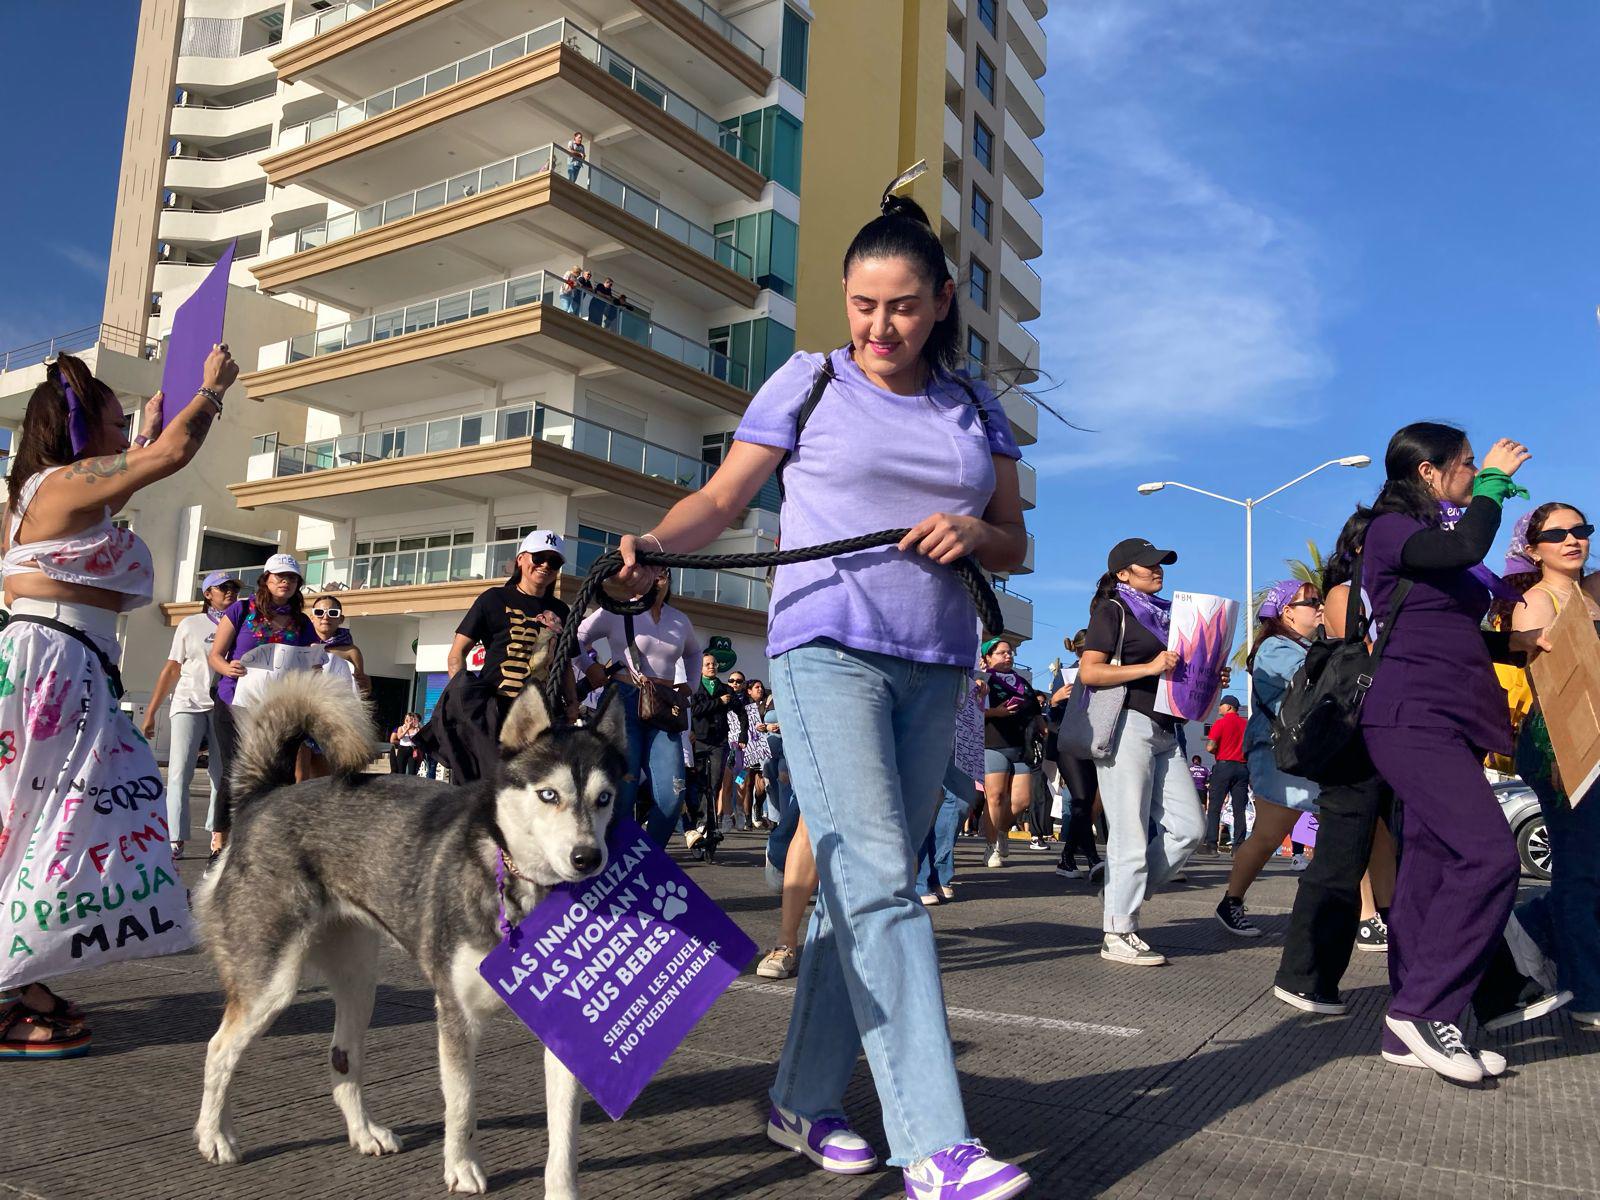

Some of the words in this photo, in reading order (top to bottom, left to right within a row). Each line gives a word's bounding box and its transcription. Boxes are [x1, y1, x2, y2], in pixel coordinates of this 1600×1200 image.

[545, 533, 557, 547] NY
[499, 952, 538, 996] LAS
[534, 838, 652, 958] INMOBILIZAN
[529, 960, 570, 1001] LAS
[564, 887, 638, 961] VIOLAN
[632, 872, 651, 892] Y
[562, 923, 638, 1000] VENDEN
[637, 910, 656, 931] A
[582, 981, 620, 1023] SUS
[615, 928, 676, 986] BEBES.
[603, 995, 649, 1047] SIENTEN
[647, 971, 669, 996] LES
[666, 935, 702, 976] DUELE
[610, 1051, 624, 1065] Y
[619, 1032, 639, 1056] NO
[636, 987, 681, 1036] PUEDEN
[676, 940, 721, 989] HABLAR
